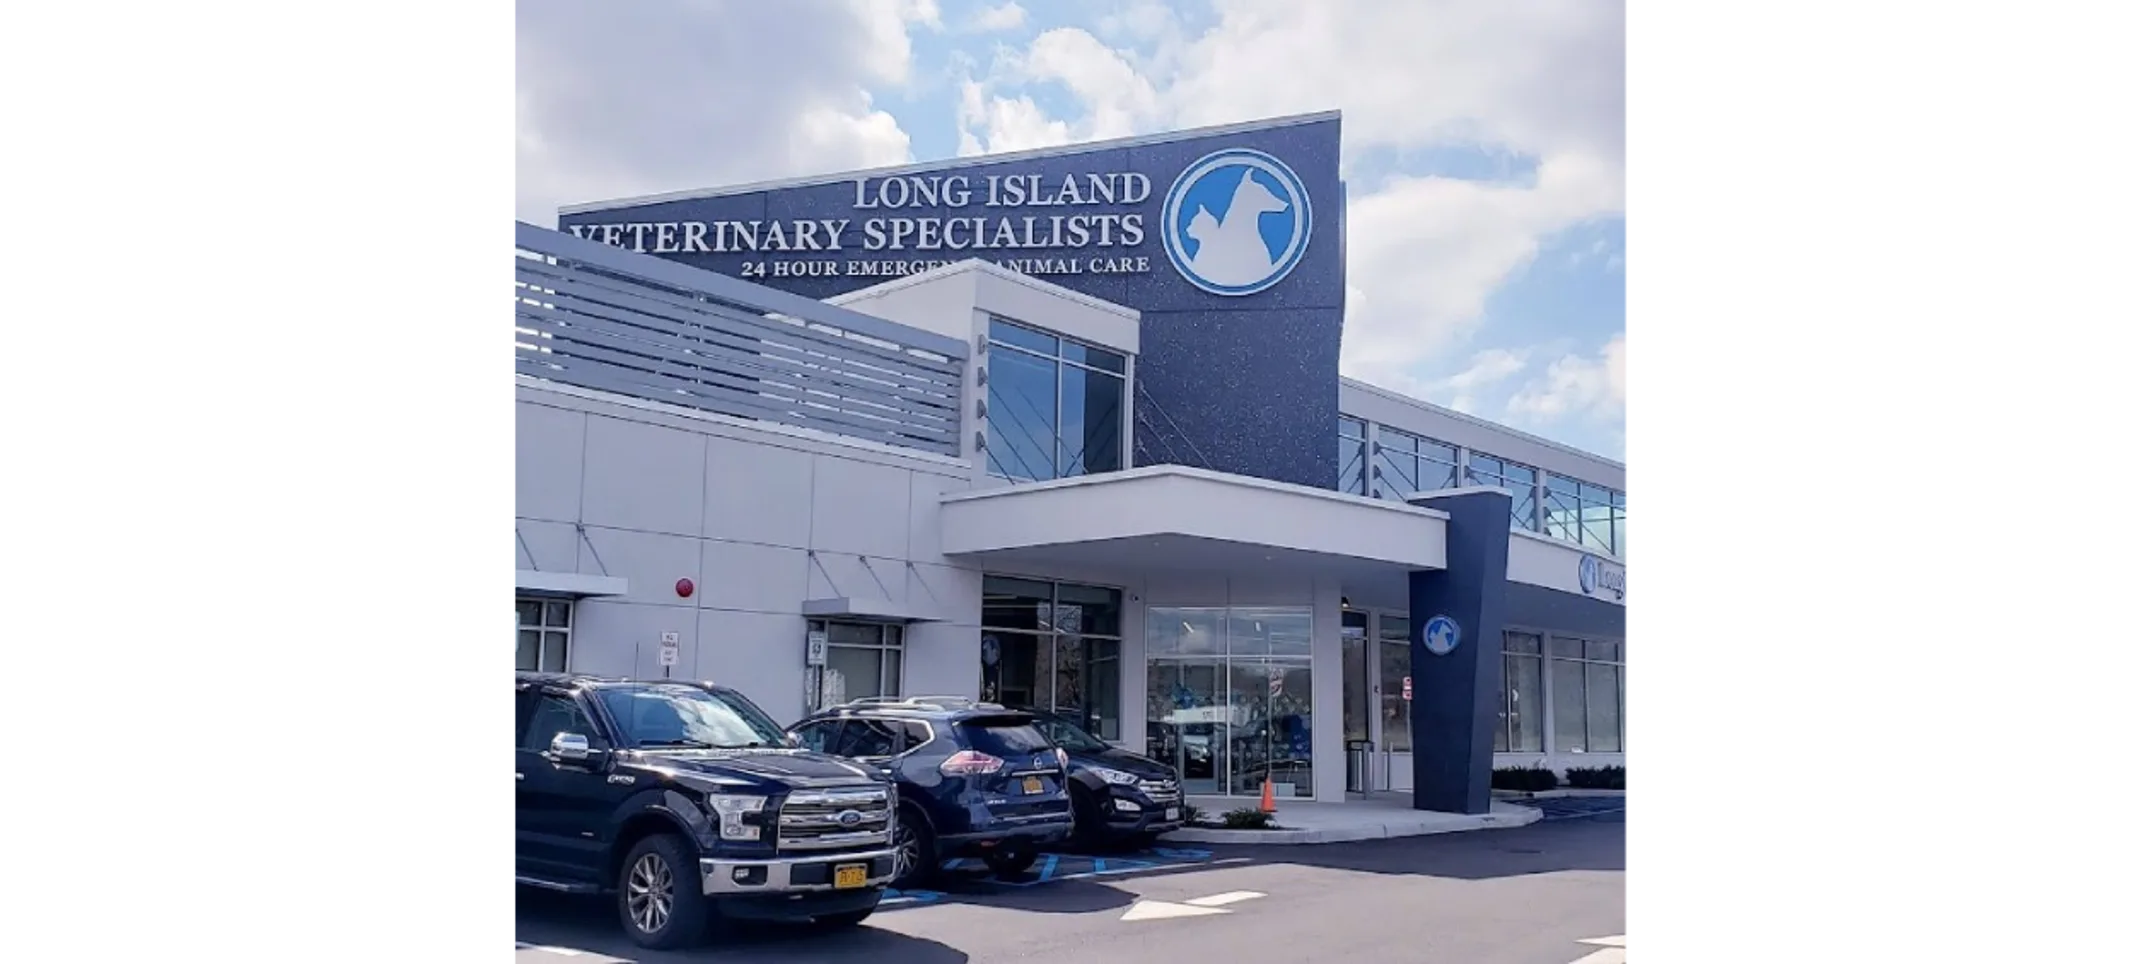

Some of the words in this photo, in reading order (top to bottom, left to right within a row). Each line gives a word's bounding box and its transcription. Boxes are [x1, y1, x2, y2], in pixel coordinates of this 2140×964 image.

[852, 175, 972, 208] LONG
[985, 173, 1151, 207] ISLAND
[569, 219, 850, 253] VETERINARY
[863, 214, 1145, 250] SPECIALISTS
[741, 261, 766, 277] 24
[773, 260, 839, 276] HOUR
[996, 260, 1083, 274] NIMAL
[1089, 256, 1151, 273] CARE
